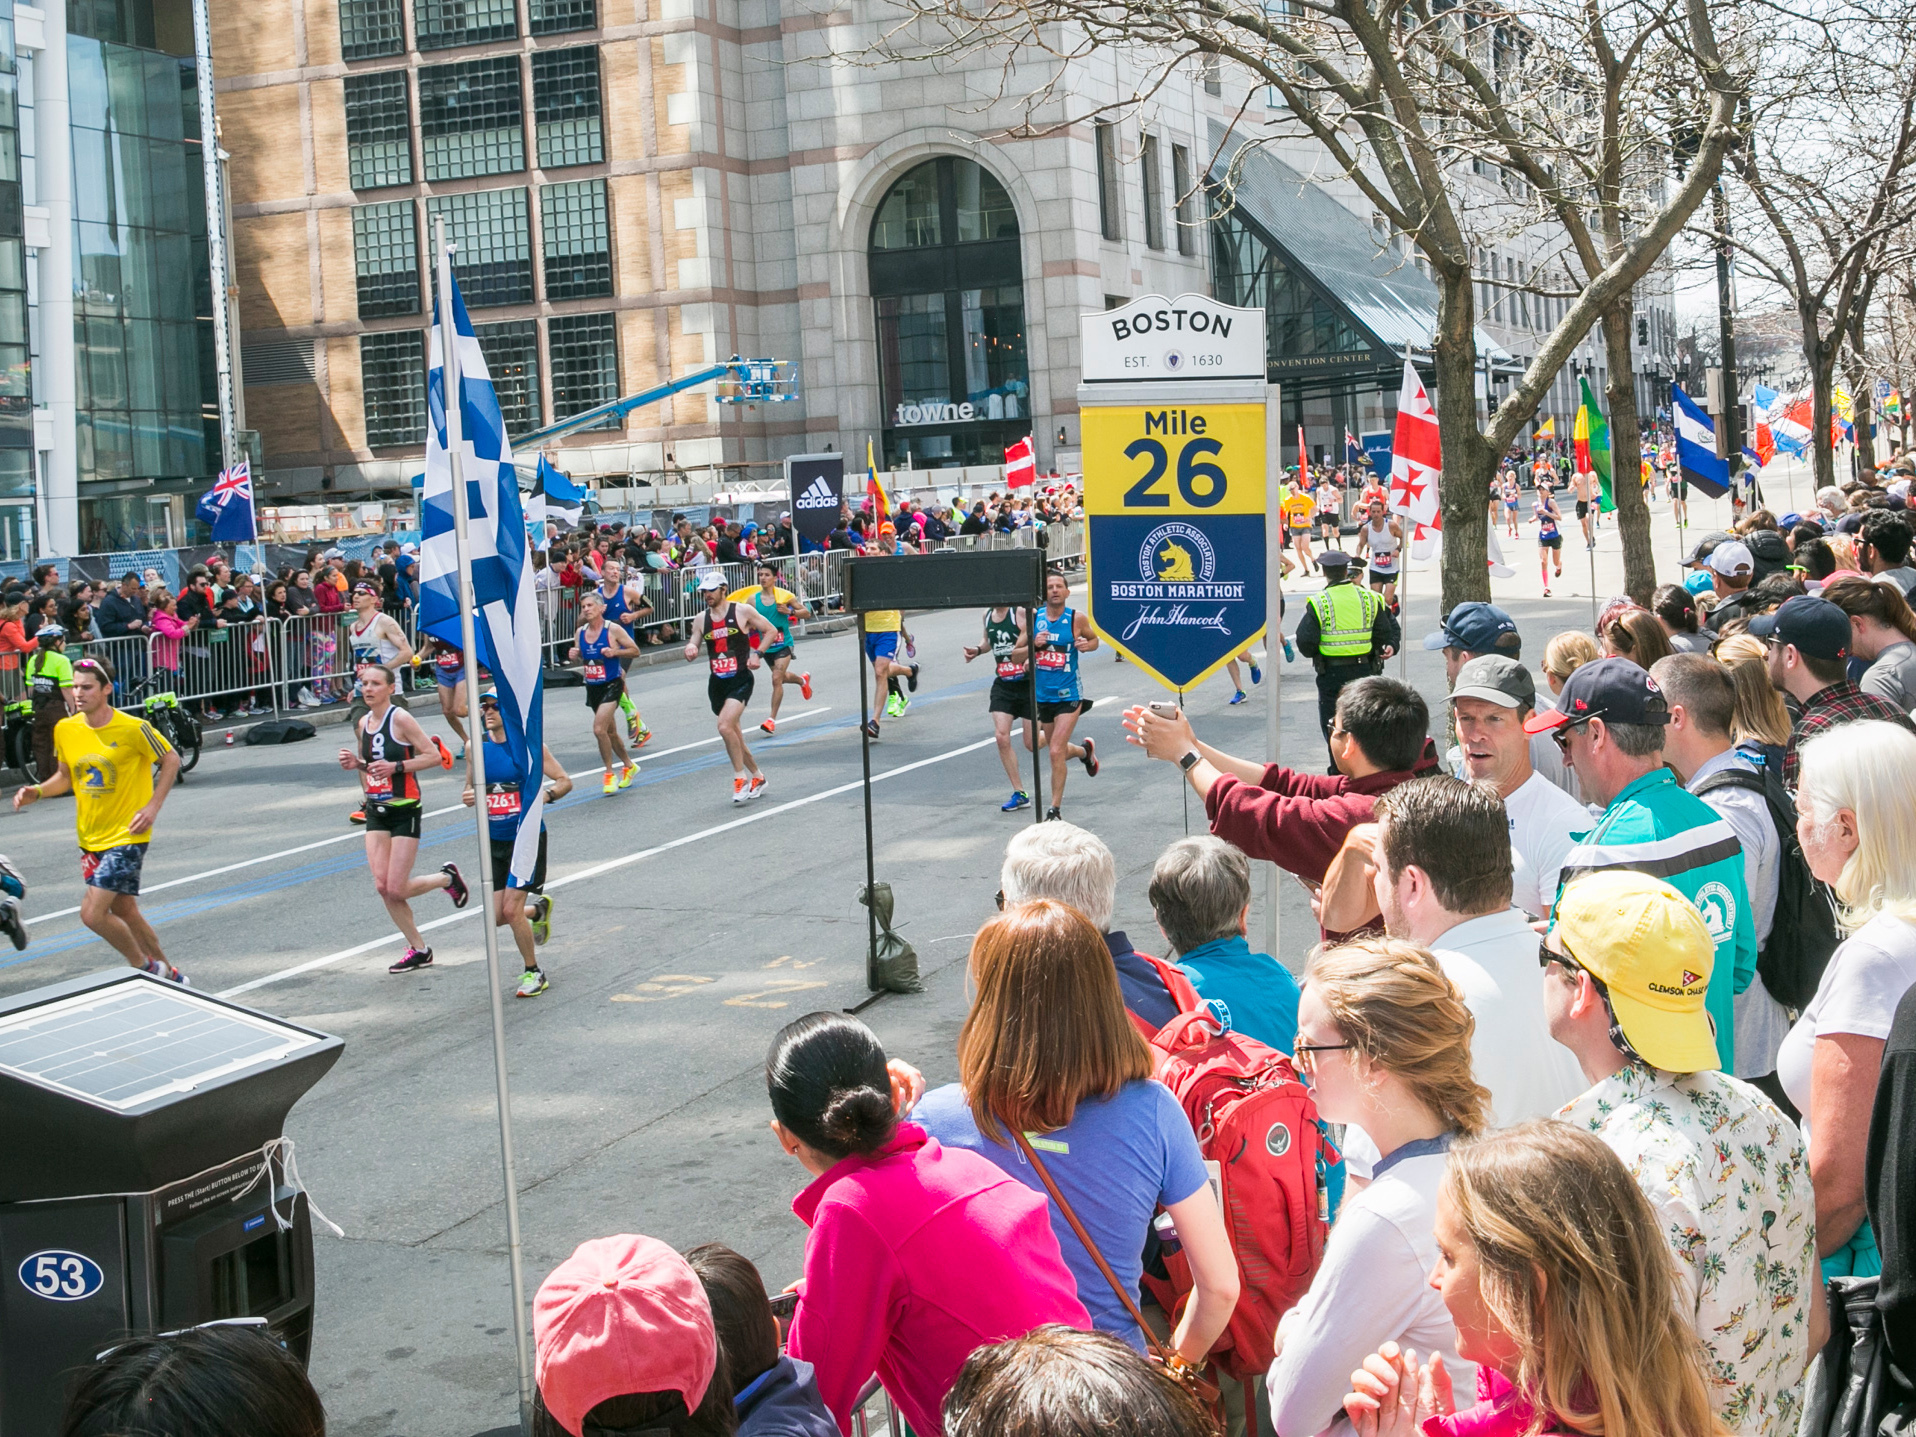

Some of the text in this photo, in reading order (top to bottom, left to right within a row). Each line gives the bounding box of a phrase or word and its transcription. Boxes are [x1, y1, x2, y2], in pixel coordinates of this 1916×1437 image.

[1111, 309, 1233, 342] BOSTON
[1124, 354, 1223, 368] EST. 1630
[1266, 353, 1371, 369] ONVENTION CENTER
[896, 402, 974, 425] towne
[1145, 410, 1207, 435] Mile
[1123, 437, 1228, 508] 26
[796, 496, 839, 509] adidas
[1142, 525, 1213, 578] BOSTON ATHLETIC ASSOCIATION
[1111, 585, 1243, 597] BOSTON MARATHON
[1122, 603, 1231, 640] John Hancock
[712, 658, 736, 669] 5172
[1038, 651, 1063, 663] 3433
[371, 732, 386, 760] on
[485, 793, 516, 808] 5261
[1648, 982, 1685, 996] CLEMSON
[168, 1195, 184, 1207] PRESS
[184, 1190, 195, 1201] THE
[211, 1176, 232, 1190] BUTTON
[232, 1168, 249, 1182] BELOW
[249, 1164, 257, 1173] TO
[35, 1257, 86, 1296] 53
